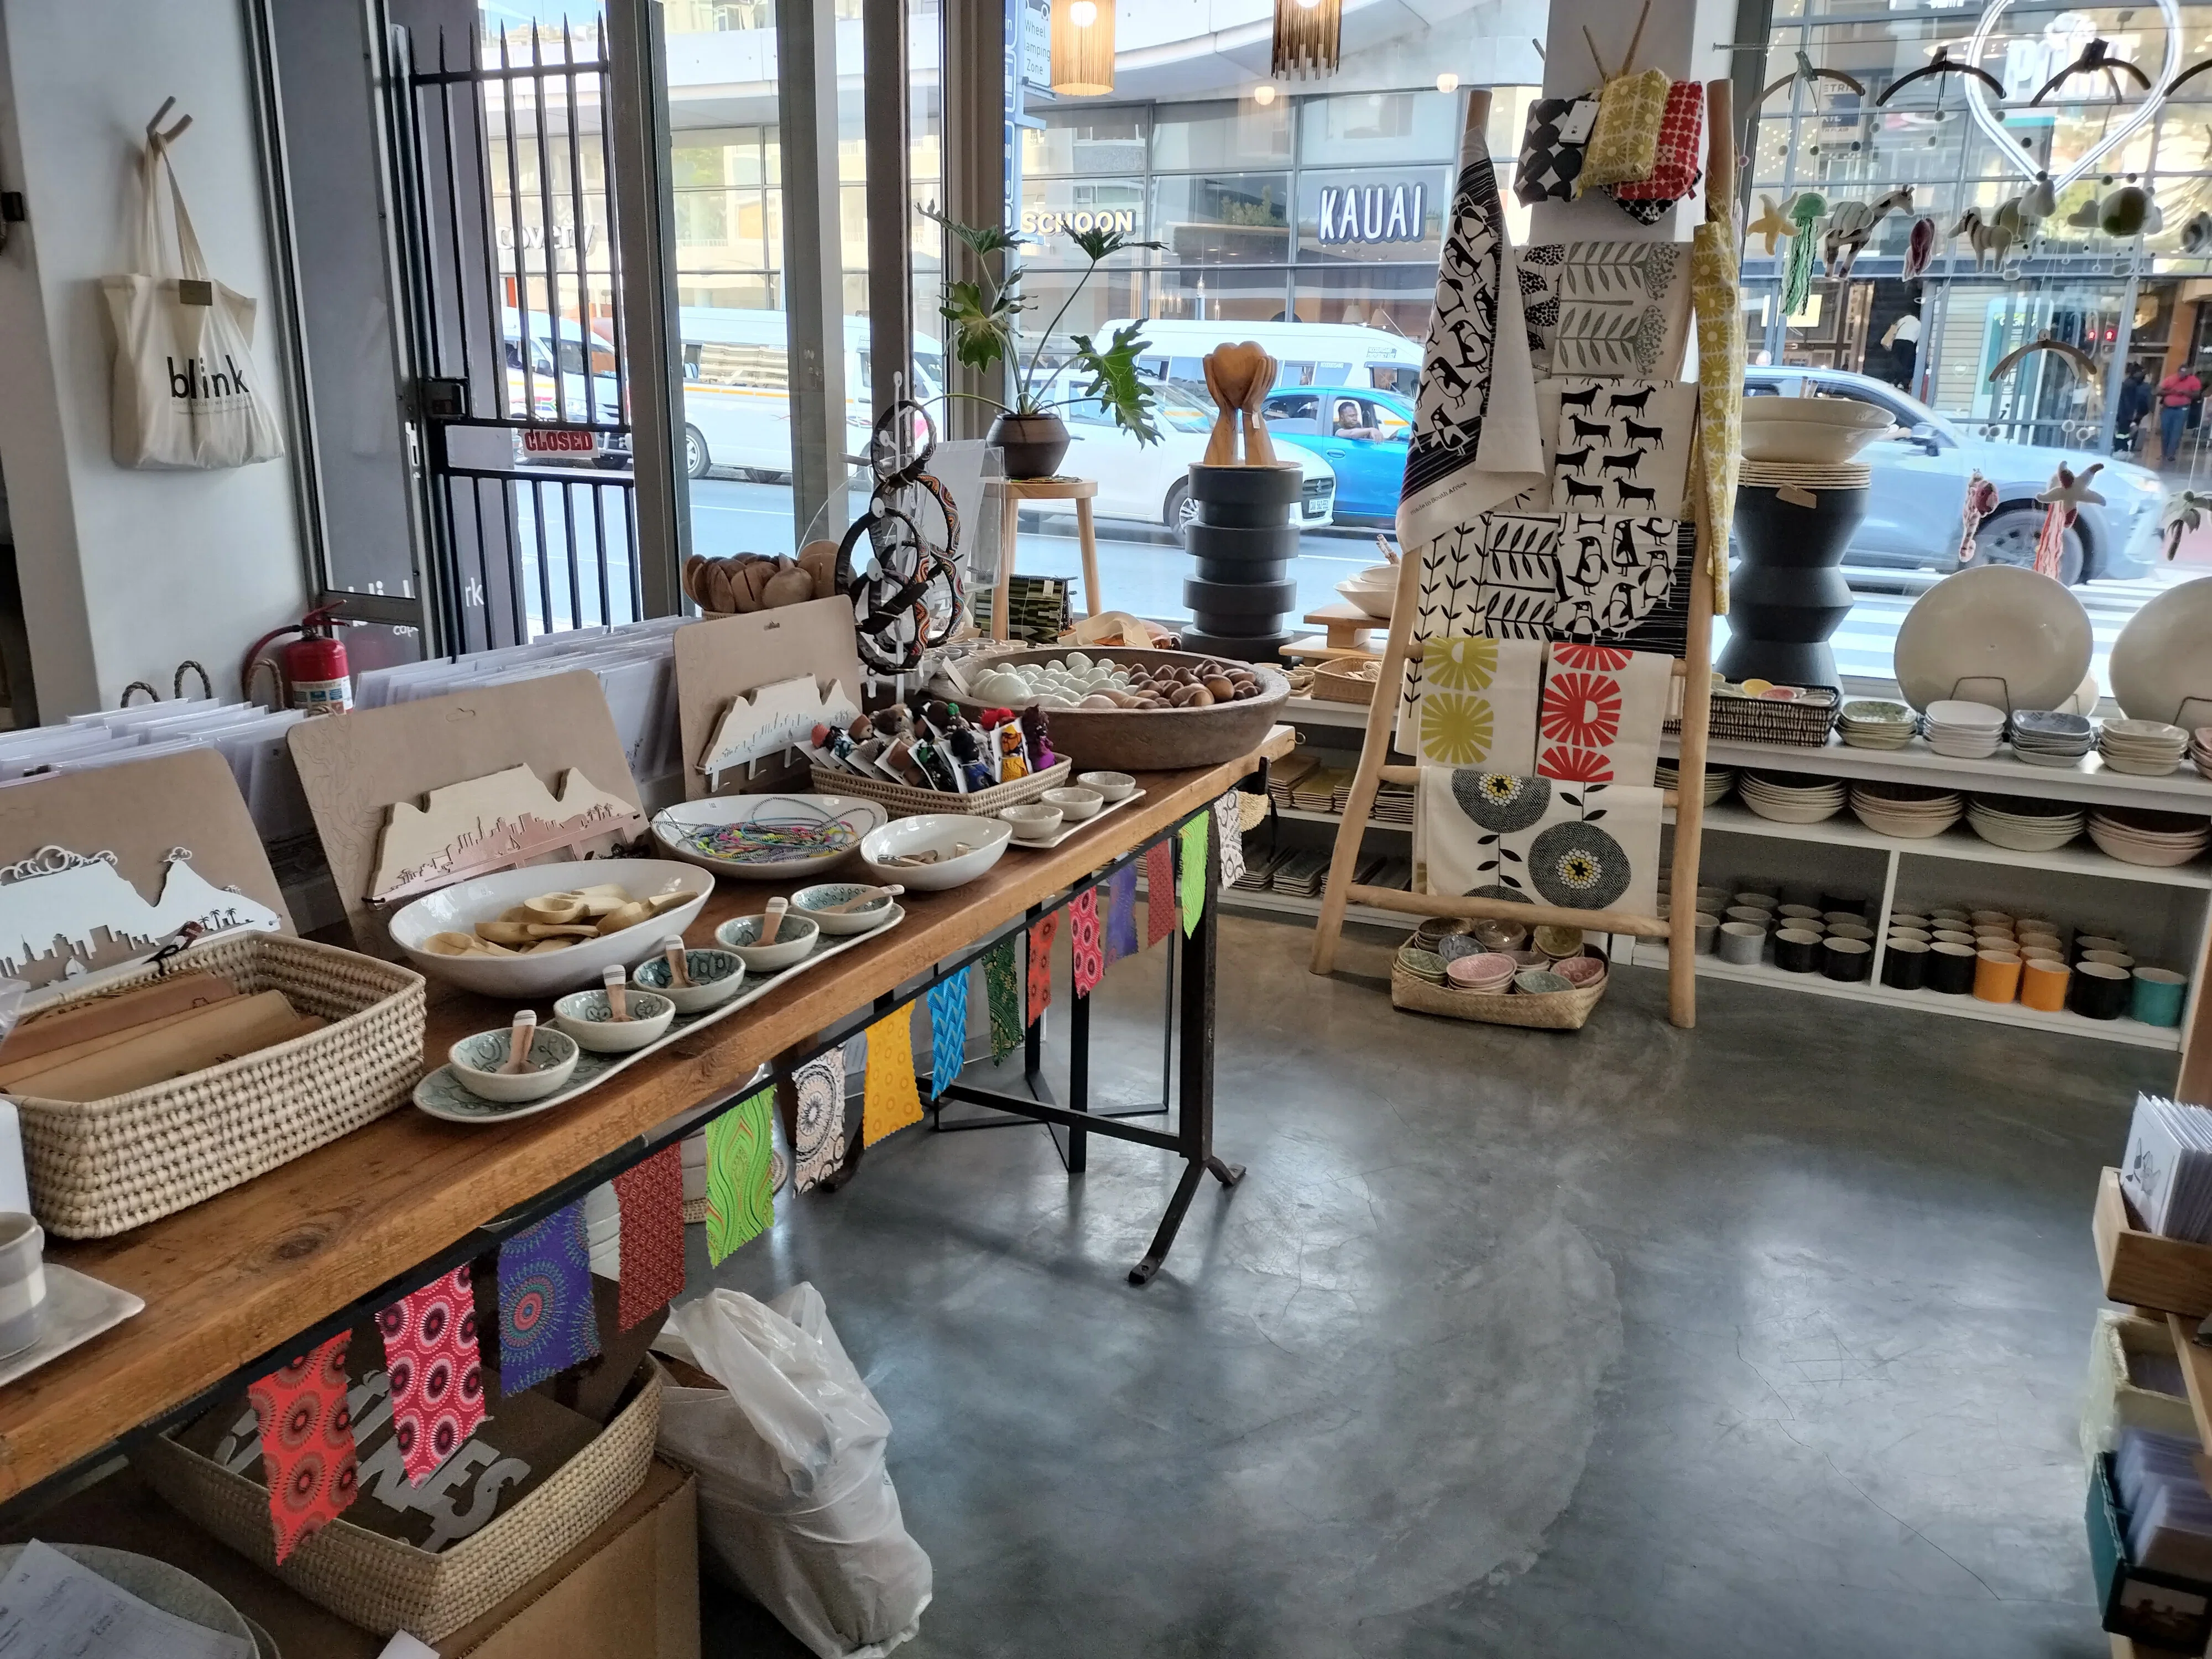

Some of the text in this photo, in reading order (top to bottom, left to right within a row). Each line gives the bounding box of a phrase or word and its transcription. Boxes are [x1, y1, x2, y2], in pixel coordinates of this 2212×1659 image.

[1025, 19, 1046, 38] Wheel
[1024, 39, 1051, 62] lamping
[1026, 58, 1044, 75] Zone
[1021, 211, 1134, 234] SCHOON
[1320, 185, 1421, 239] KAUAI
[166, 354, 250, 399] blink
[524, 431, 593, 451] CLOSED
[1410, 504, 1426, 515] made
[1431, 492, 1449, 503] South
[1448, 482, 1468, 494] Africa
